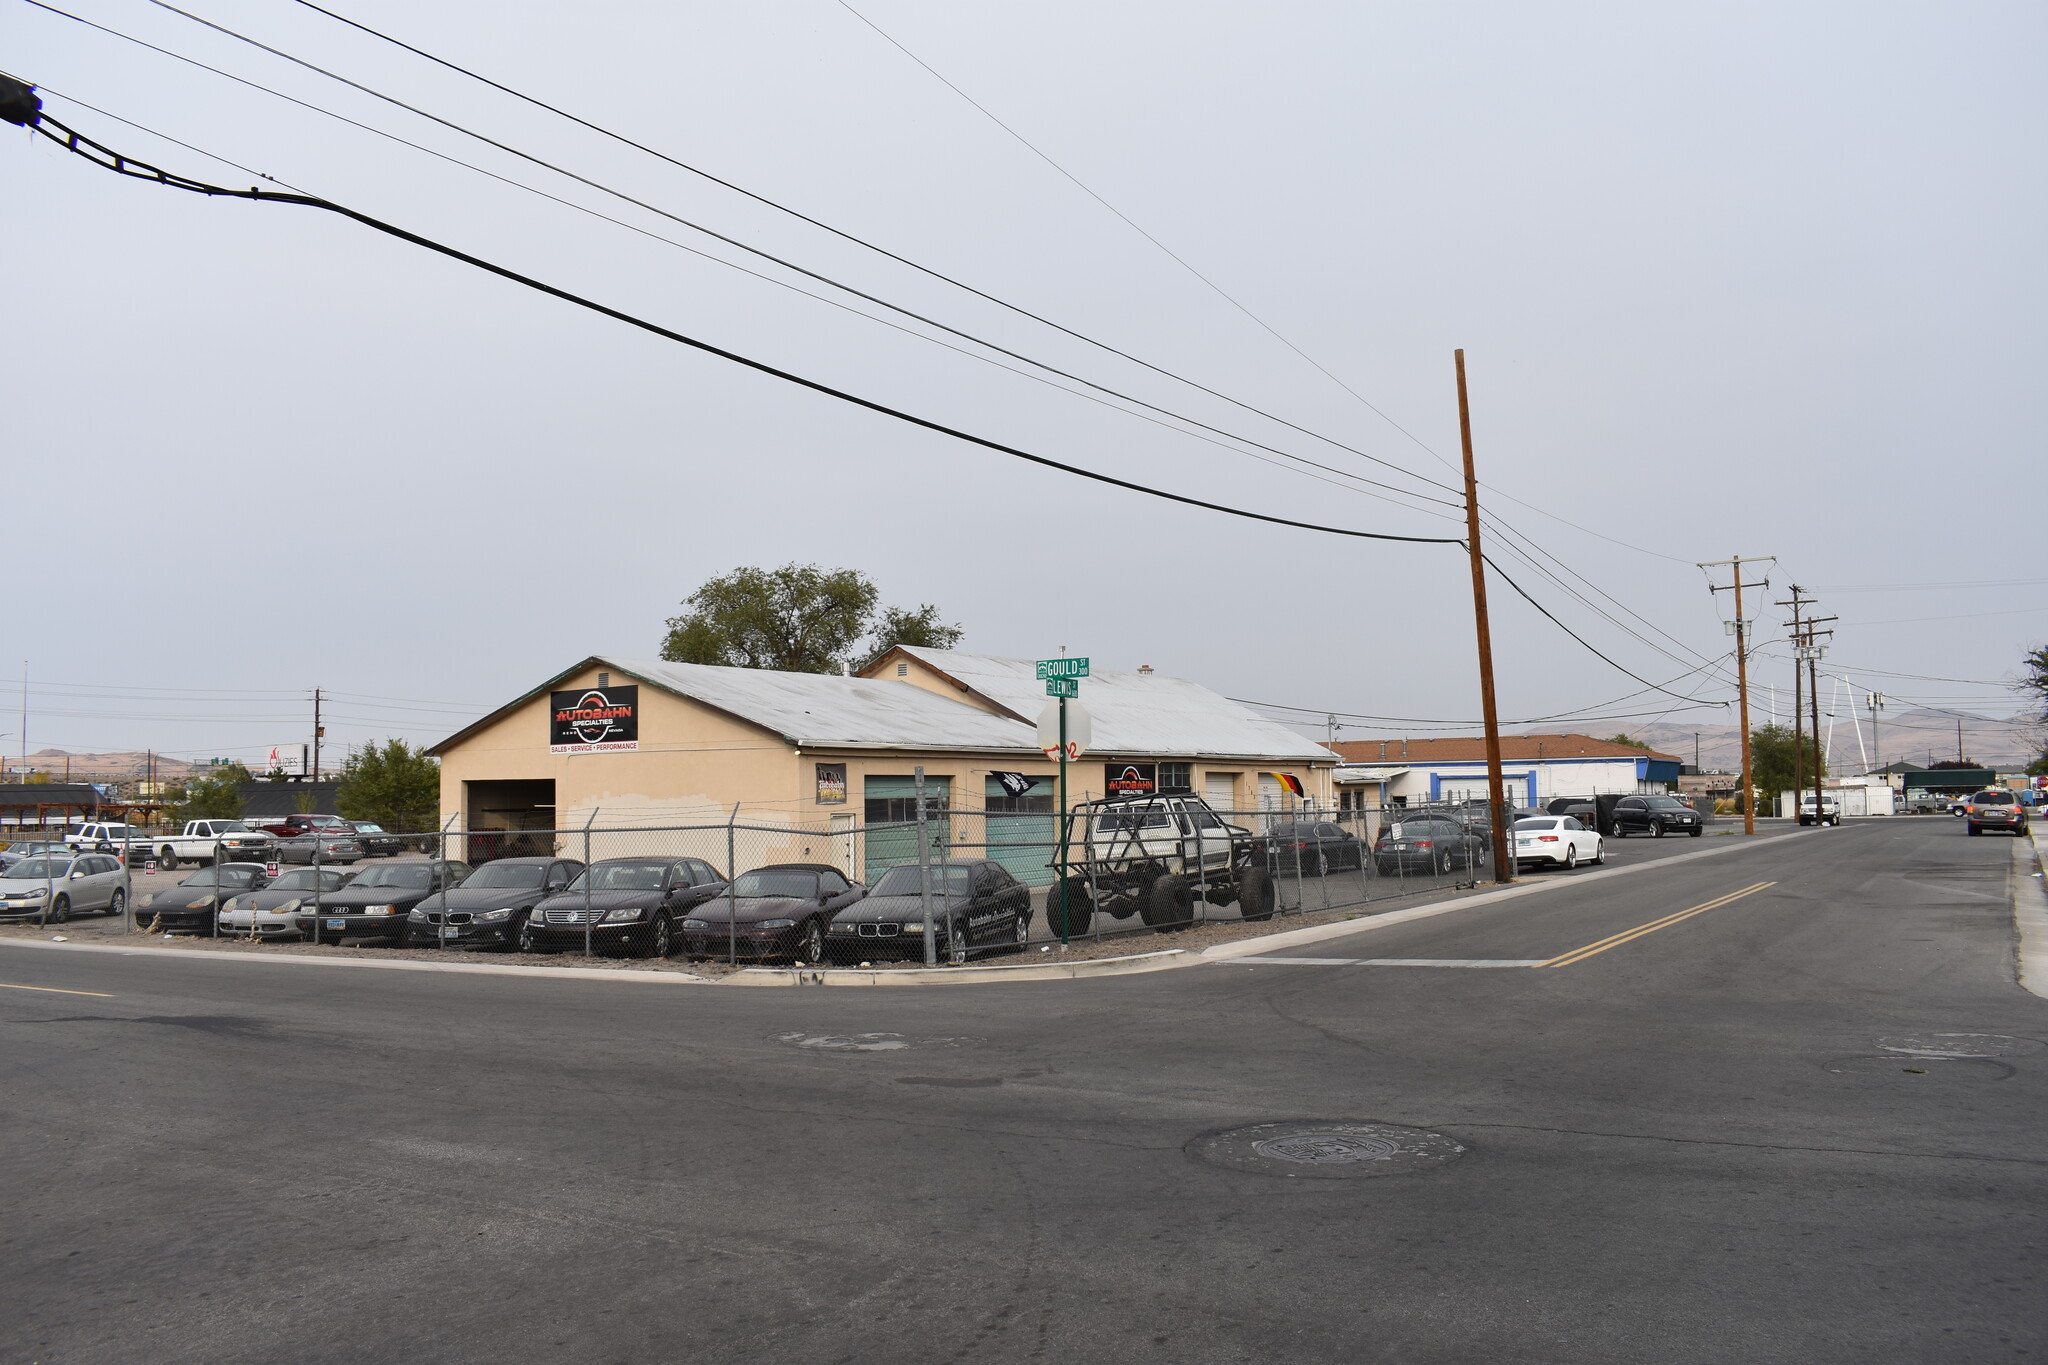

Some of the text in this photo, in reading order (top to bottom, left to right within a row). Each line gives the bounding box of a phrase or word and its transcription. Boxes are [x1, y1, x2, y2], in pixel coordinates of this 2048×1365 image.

[1048, 661, 1077, 676] GOULD
[1078, 667, 1088, 675] 300
[1053, 680, 1071, 695] LEWIS
[556, 707, 631, 721] AUTOBAHN
[572, 718, 613, 727] SPECIALTIES
[551, 742, 637, 753] SALES SERVICE PERFORMANCE
[1109, 781, 1152, 790] AUTOBAHN
